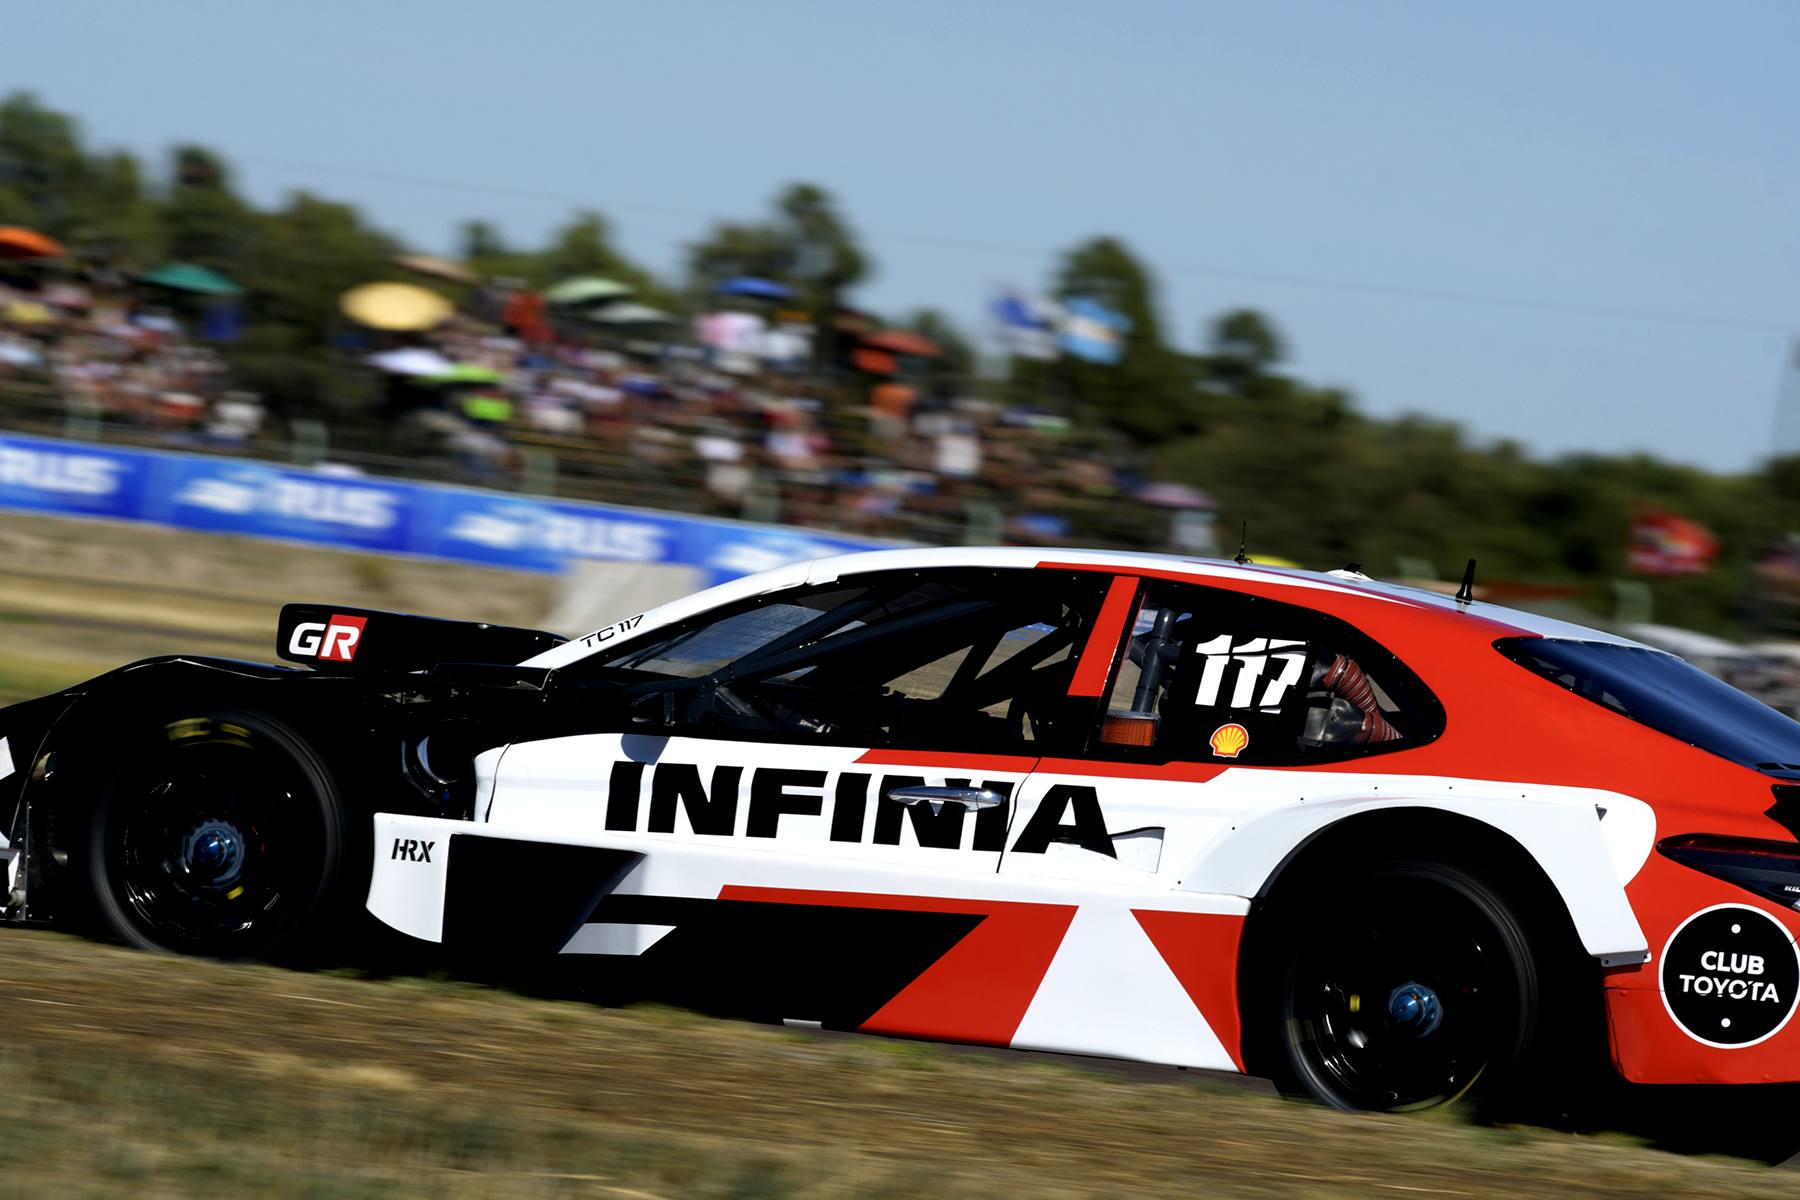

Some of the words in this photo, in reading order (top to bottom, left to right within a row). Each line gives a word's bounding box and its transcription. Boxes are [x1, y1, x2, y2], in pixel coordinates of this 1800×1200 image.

[288, 622, 361, 661] GR
[580, 627, 615, 648] TC
[618, 614, 645, 633] 117
[1194, 634, 1308, 715] 117
[604, 760, 1119, 860] INFINIA
[391, 838, 436, 863] HRX
[1700, 950, 1765, 976] CLUB
[1679, 974, 1780, 1004] TOYOTA
